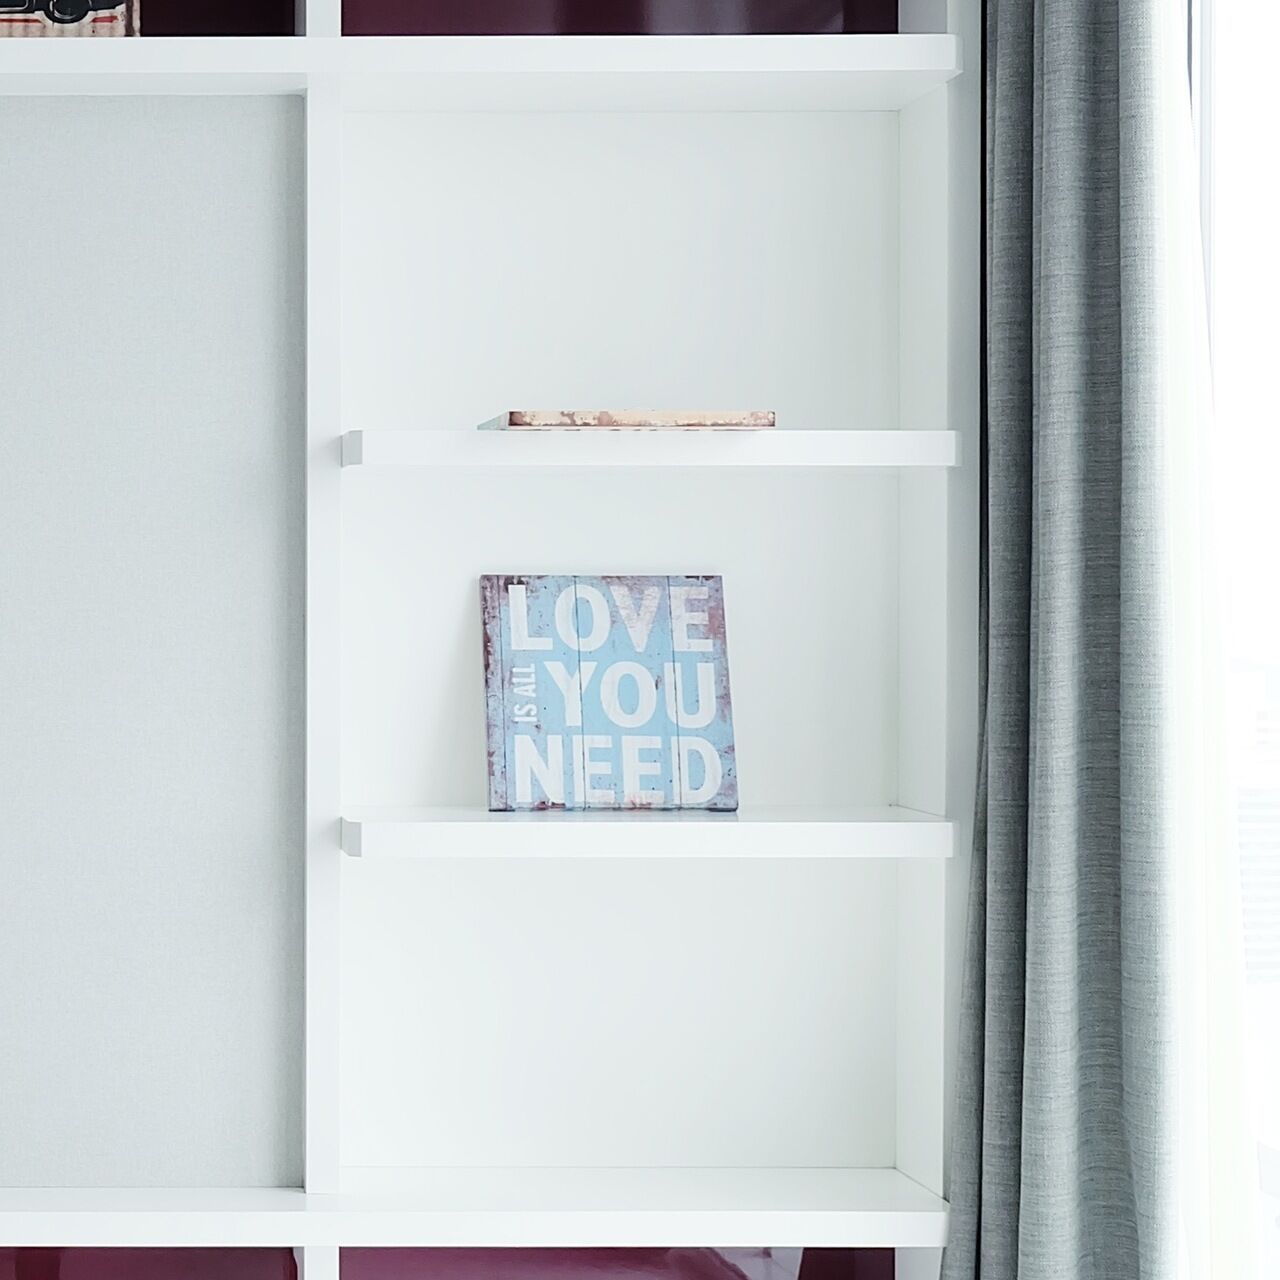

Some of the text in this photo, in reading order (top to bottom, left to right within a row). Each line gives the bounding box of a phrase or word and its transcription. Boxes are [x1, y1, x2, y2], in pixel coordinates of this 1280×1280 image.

[507, 584, 714, 653] LOVE
[512, 663, 538, 722] IS ALL
[543, 660, 717, 729] YOU
[514, 734, 723, 804] NEED
